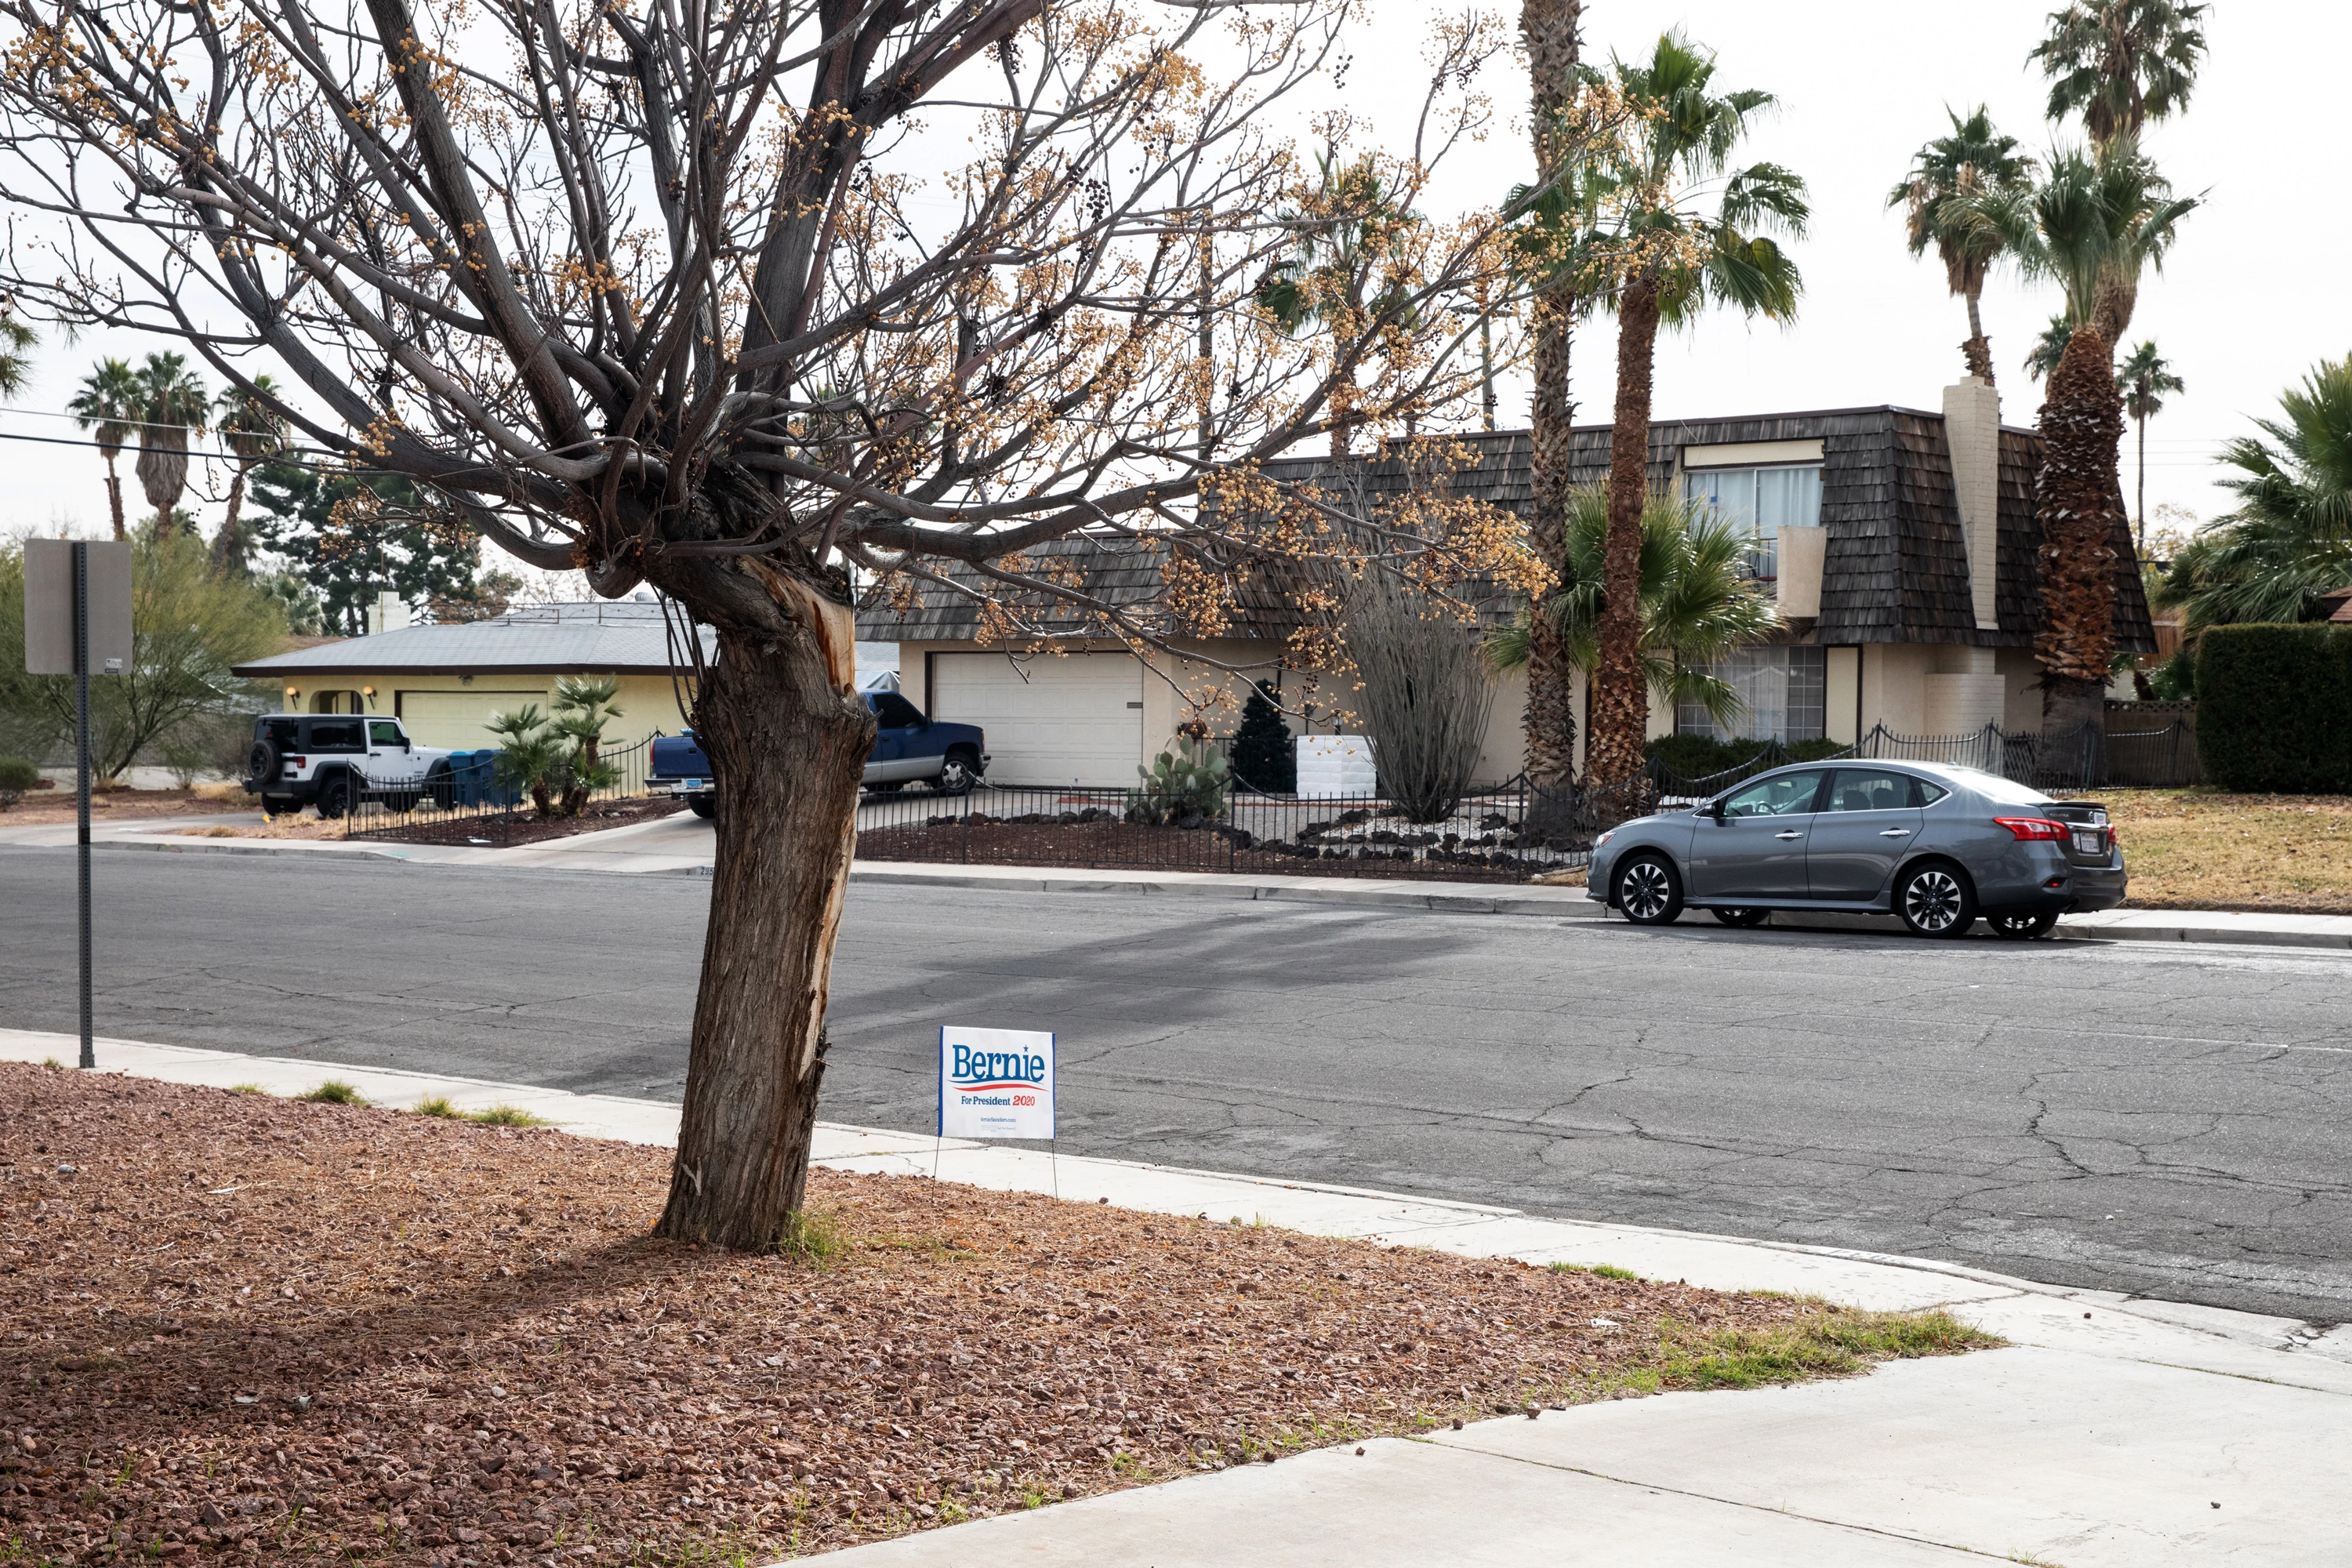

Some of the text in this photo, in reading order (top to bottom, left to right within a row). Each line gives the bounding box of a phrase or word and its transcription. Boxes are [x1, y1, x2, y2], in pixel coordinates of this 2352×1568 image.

[952, 1044, 1045, 1082] Bernie
[961, 1095, 1035, 1106] For President 2020
